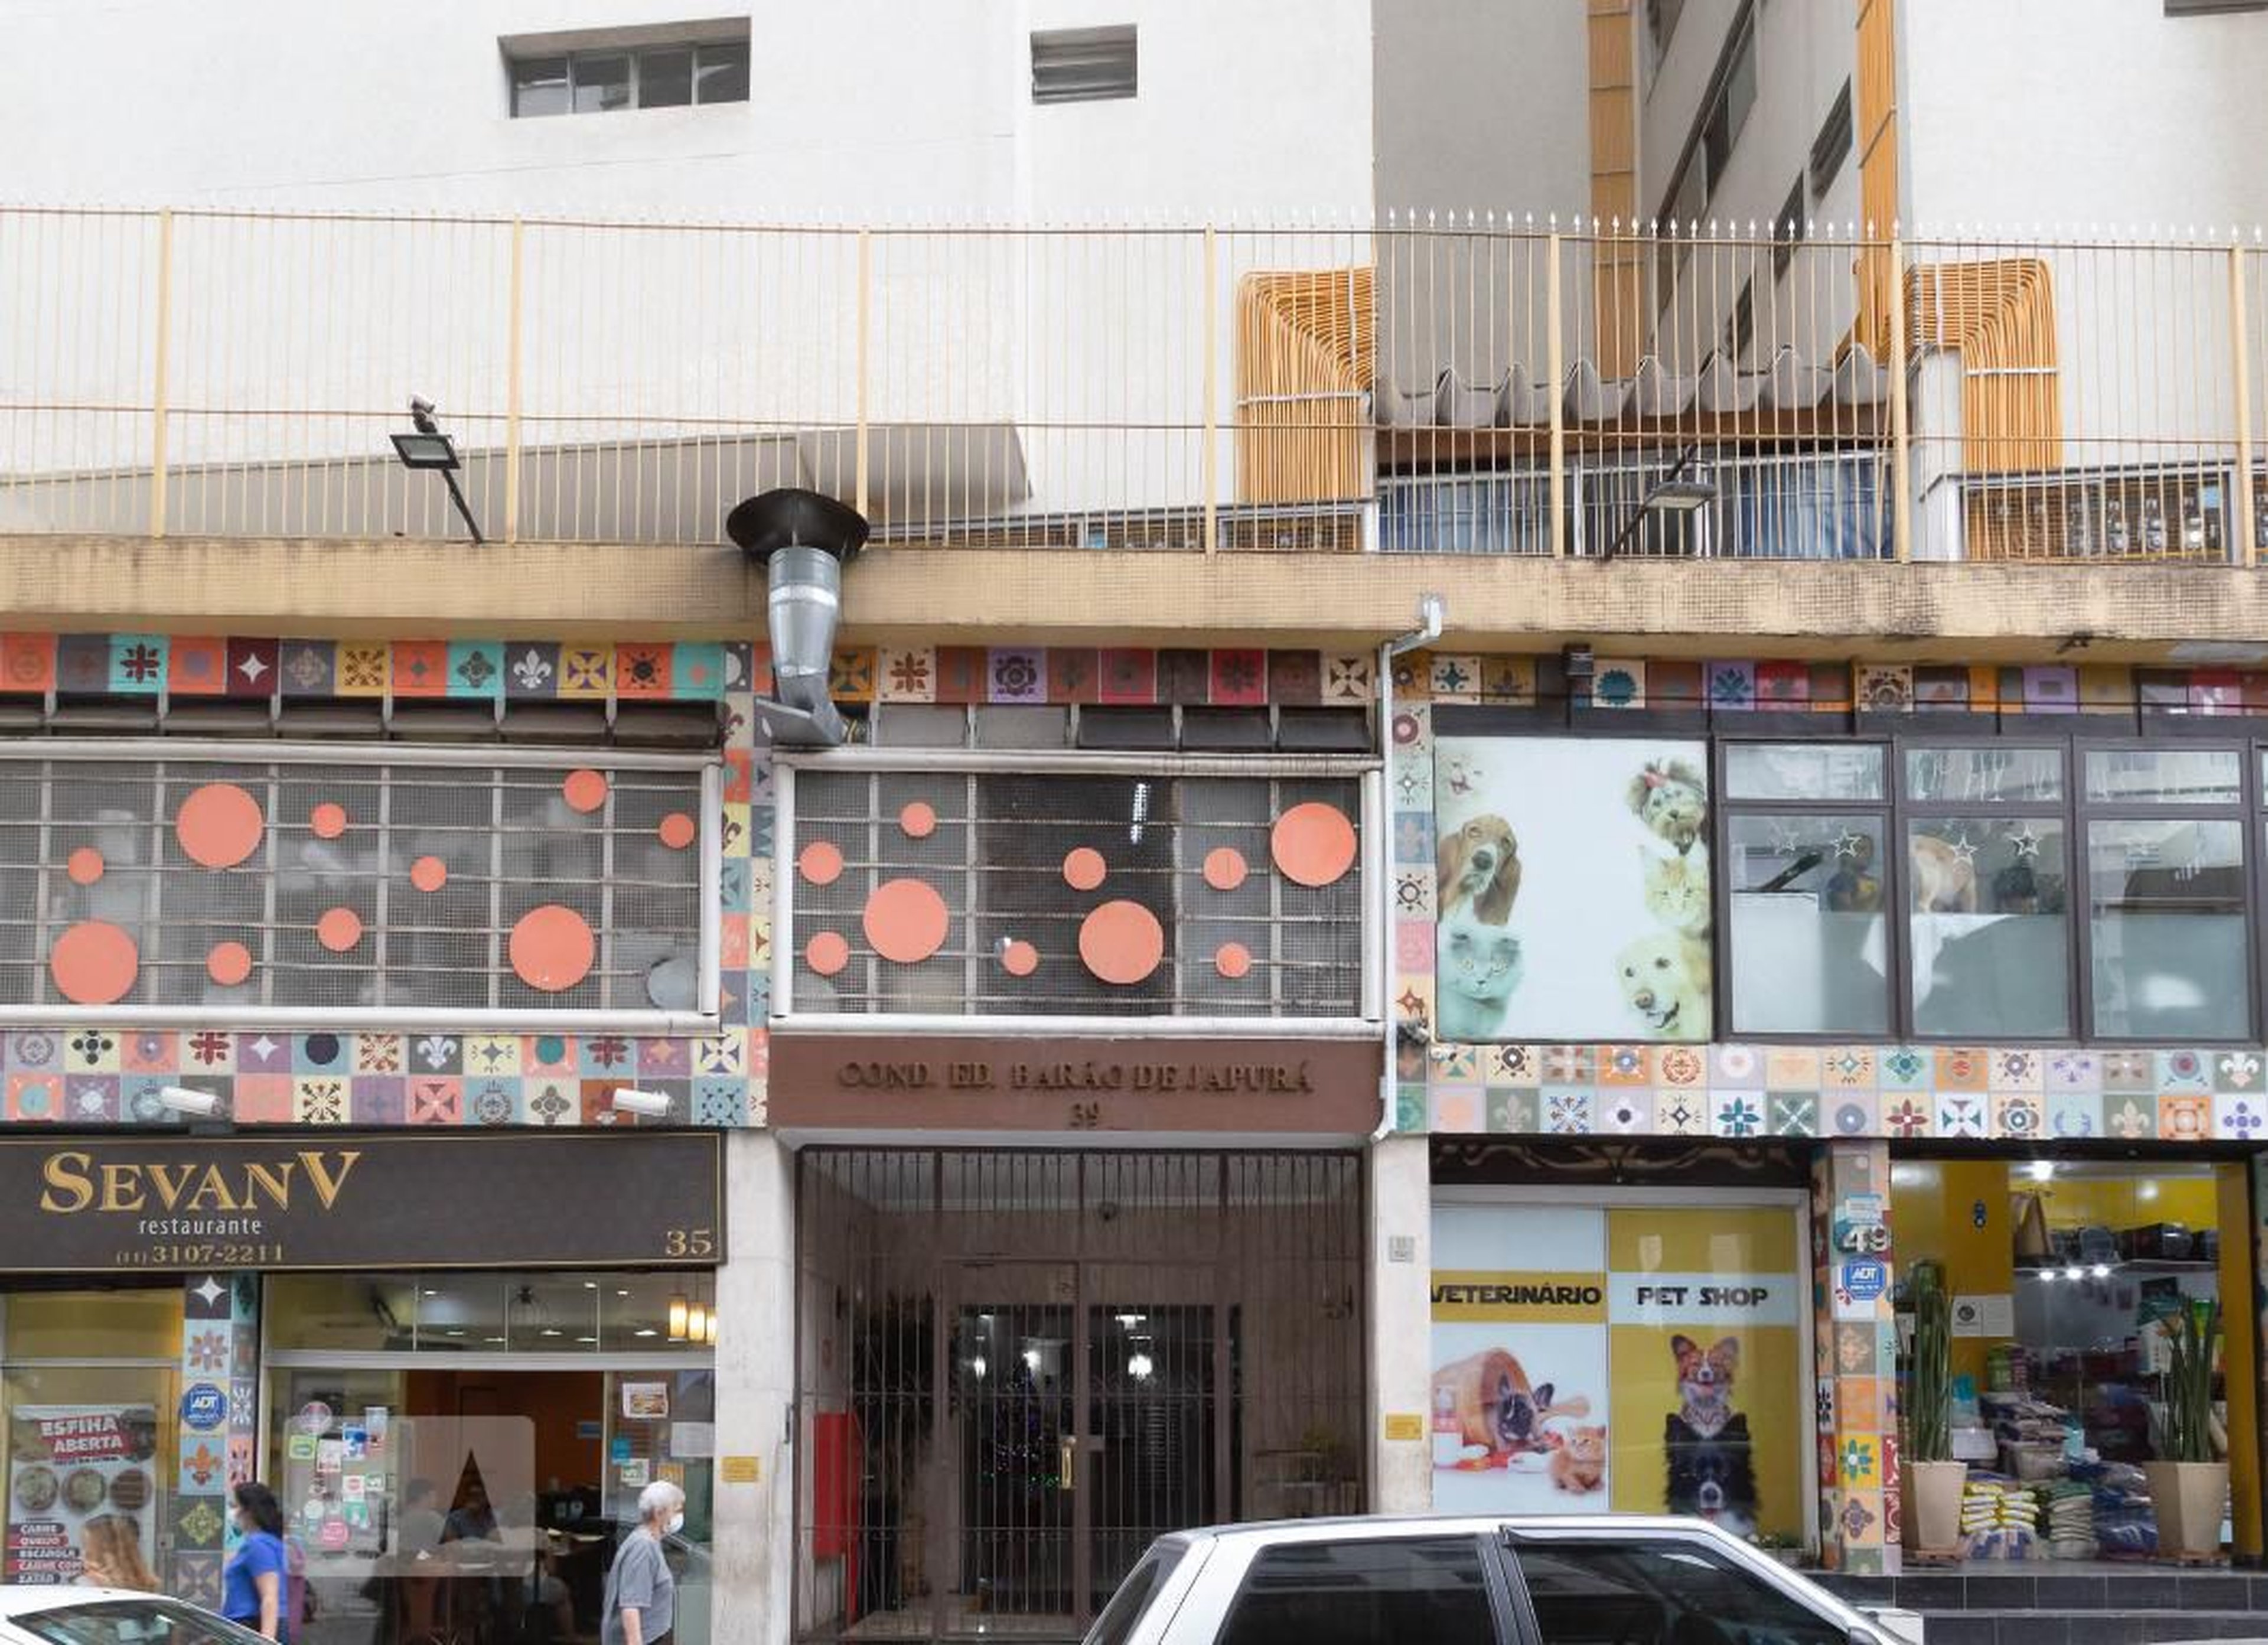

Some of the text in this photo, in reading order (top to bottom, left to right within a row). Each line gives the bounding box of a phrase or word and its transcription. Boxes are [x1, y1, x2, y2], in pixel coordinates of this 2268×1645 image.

[1133, 1064, 1178, 1091] DE
[1185, 1061, 1315, 1093] JAPURÁ
[139, 1217, 262, 1235] restaurante
[666, 1230, 712, 1257] 35
[1842, 1224, 1888, 1252] 49
[116, 1243, 284, 1264] (11) 3107-2211
[1852, 1268, 1878, 1281] ADT
[1430, 1282, 1602, 1305] VETERINÁRIO
[1637, 1287, 1768, 1307] PET SHOP
[192, 1396, 217, 1409] ADT
[40, 1416, 119, 1436] ESFIHA
[54, 1435, 123, 1453] ABERTA
[19, 1537, 60, 1546] QUEIJO
